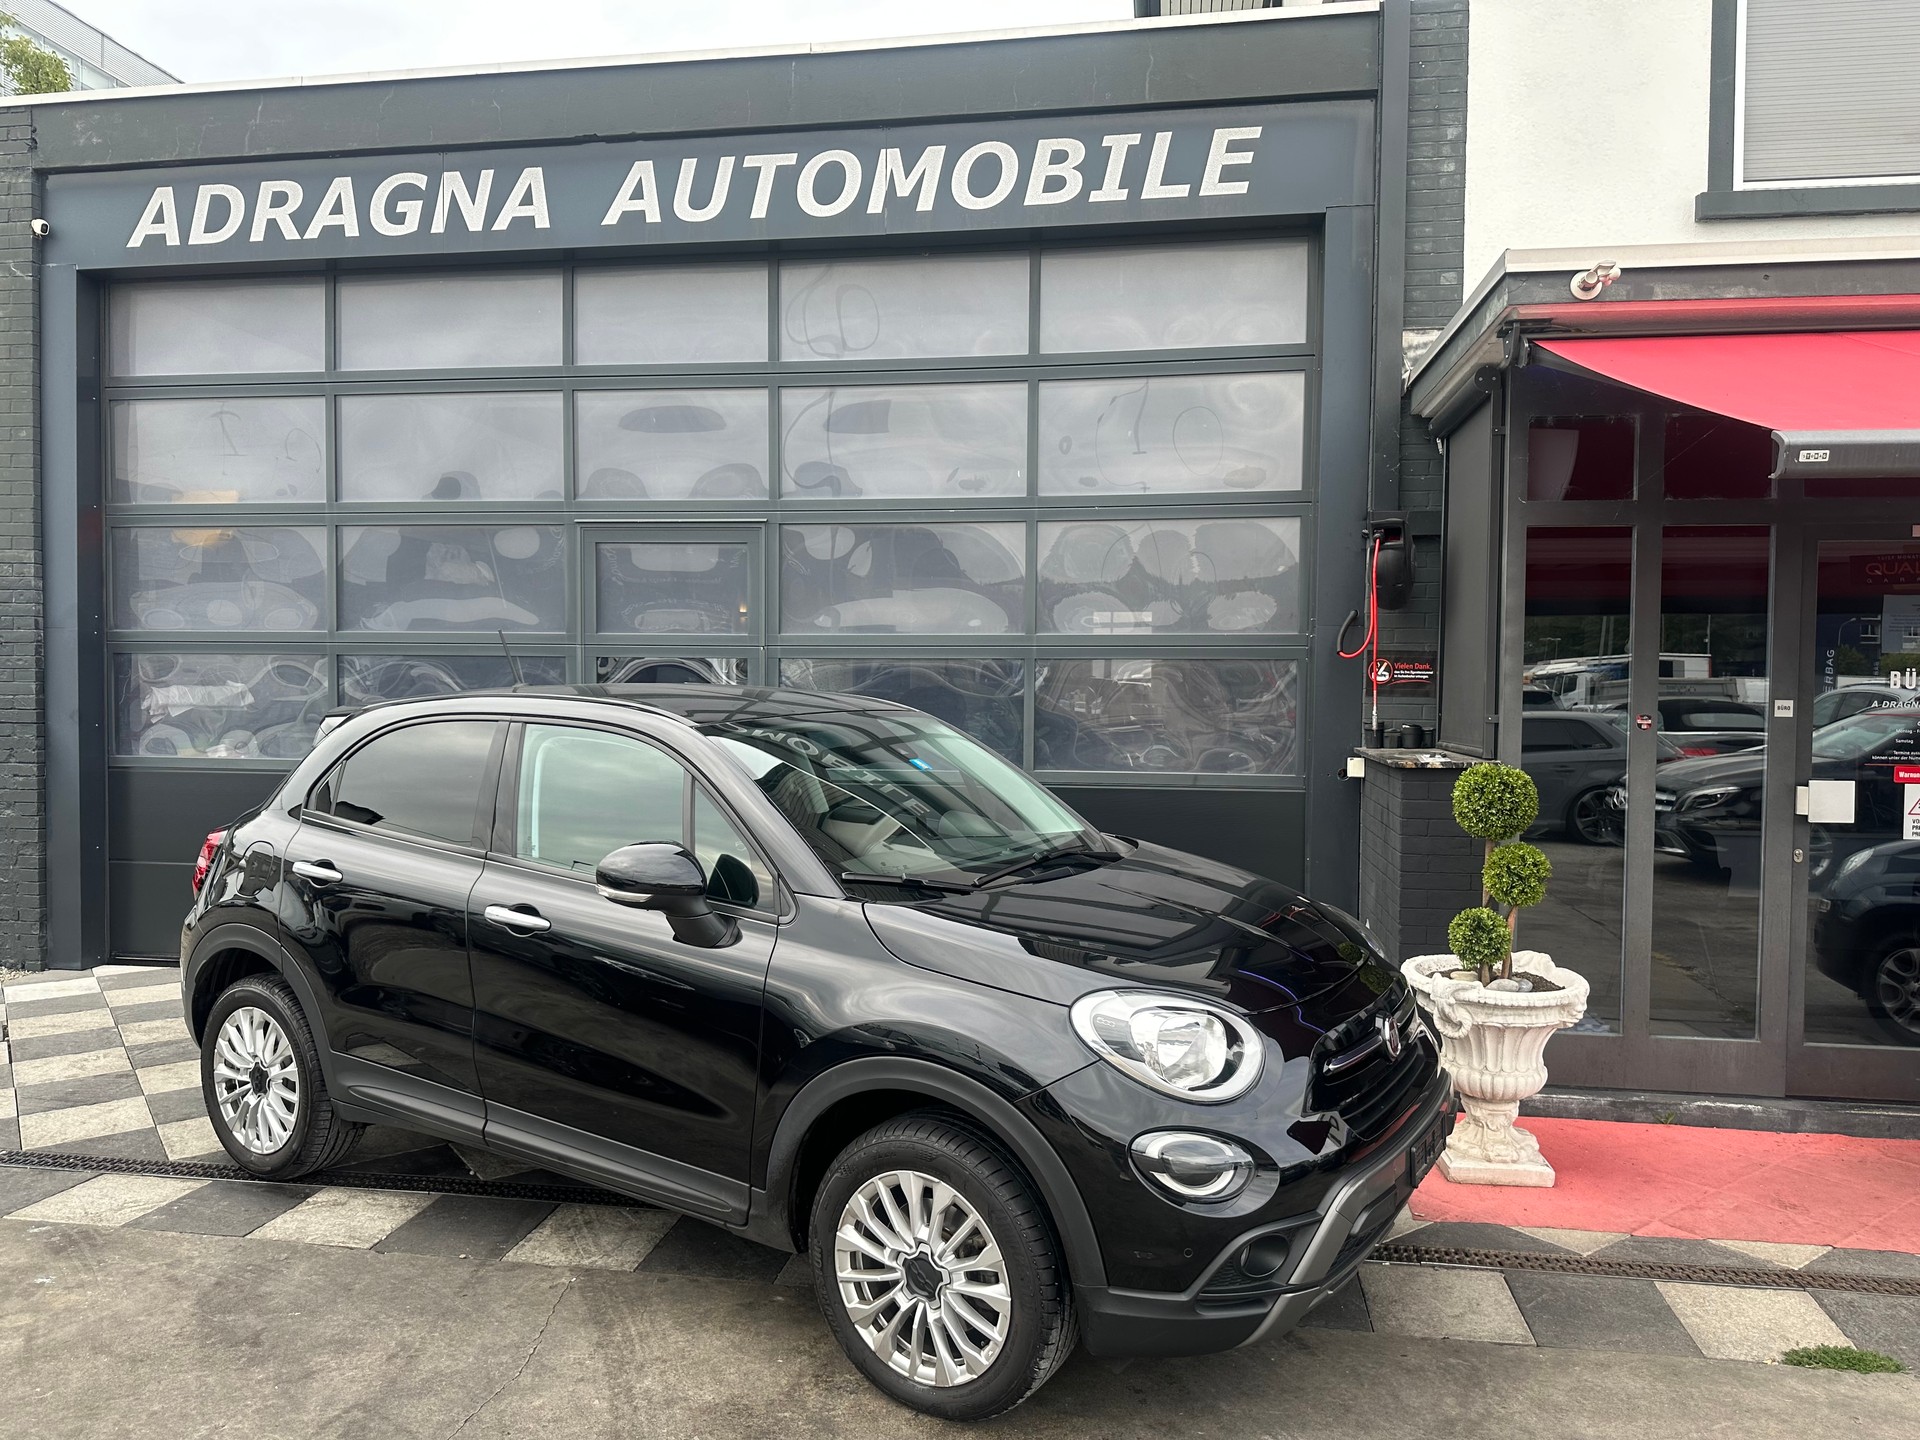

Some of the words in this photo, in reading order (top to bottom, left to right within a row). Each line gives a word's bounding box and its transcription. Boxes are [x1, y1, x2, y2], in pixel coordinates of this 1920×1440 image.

[126, 166, 551, 248] ADRAGNA
[600, 126, 1263, 226] AUTOMOBILE
[1394, 662, 1414, 670] Vielen
[1890, 667, 1917, 690] BÜ
